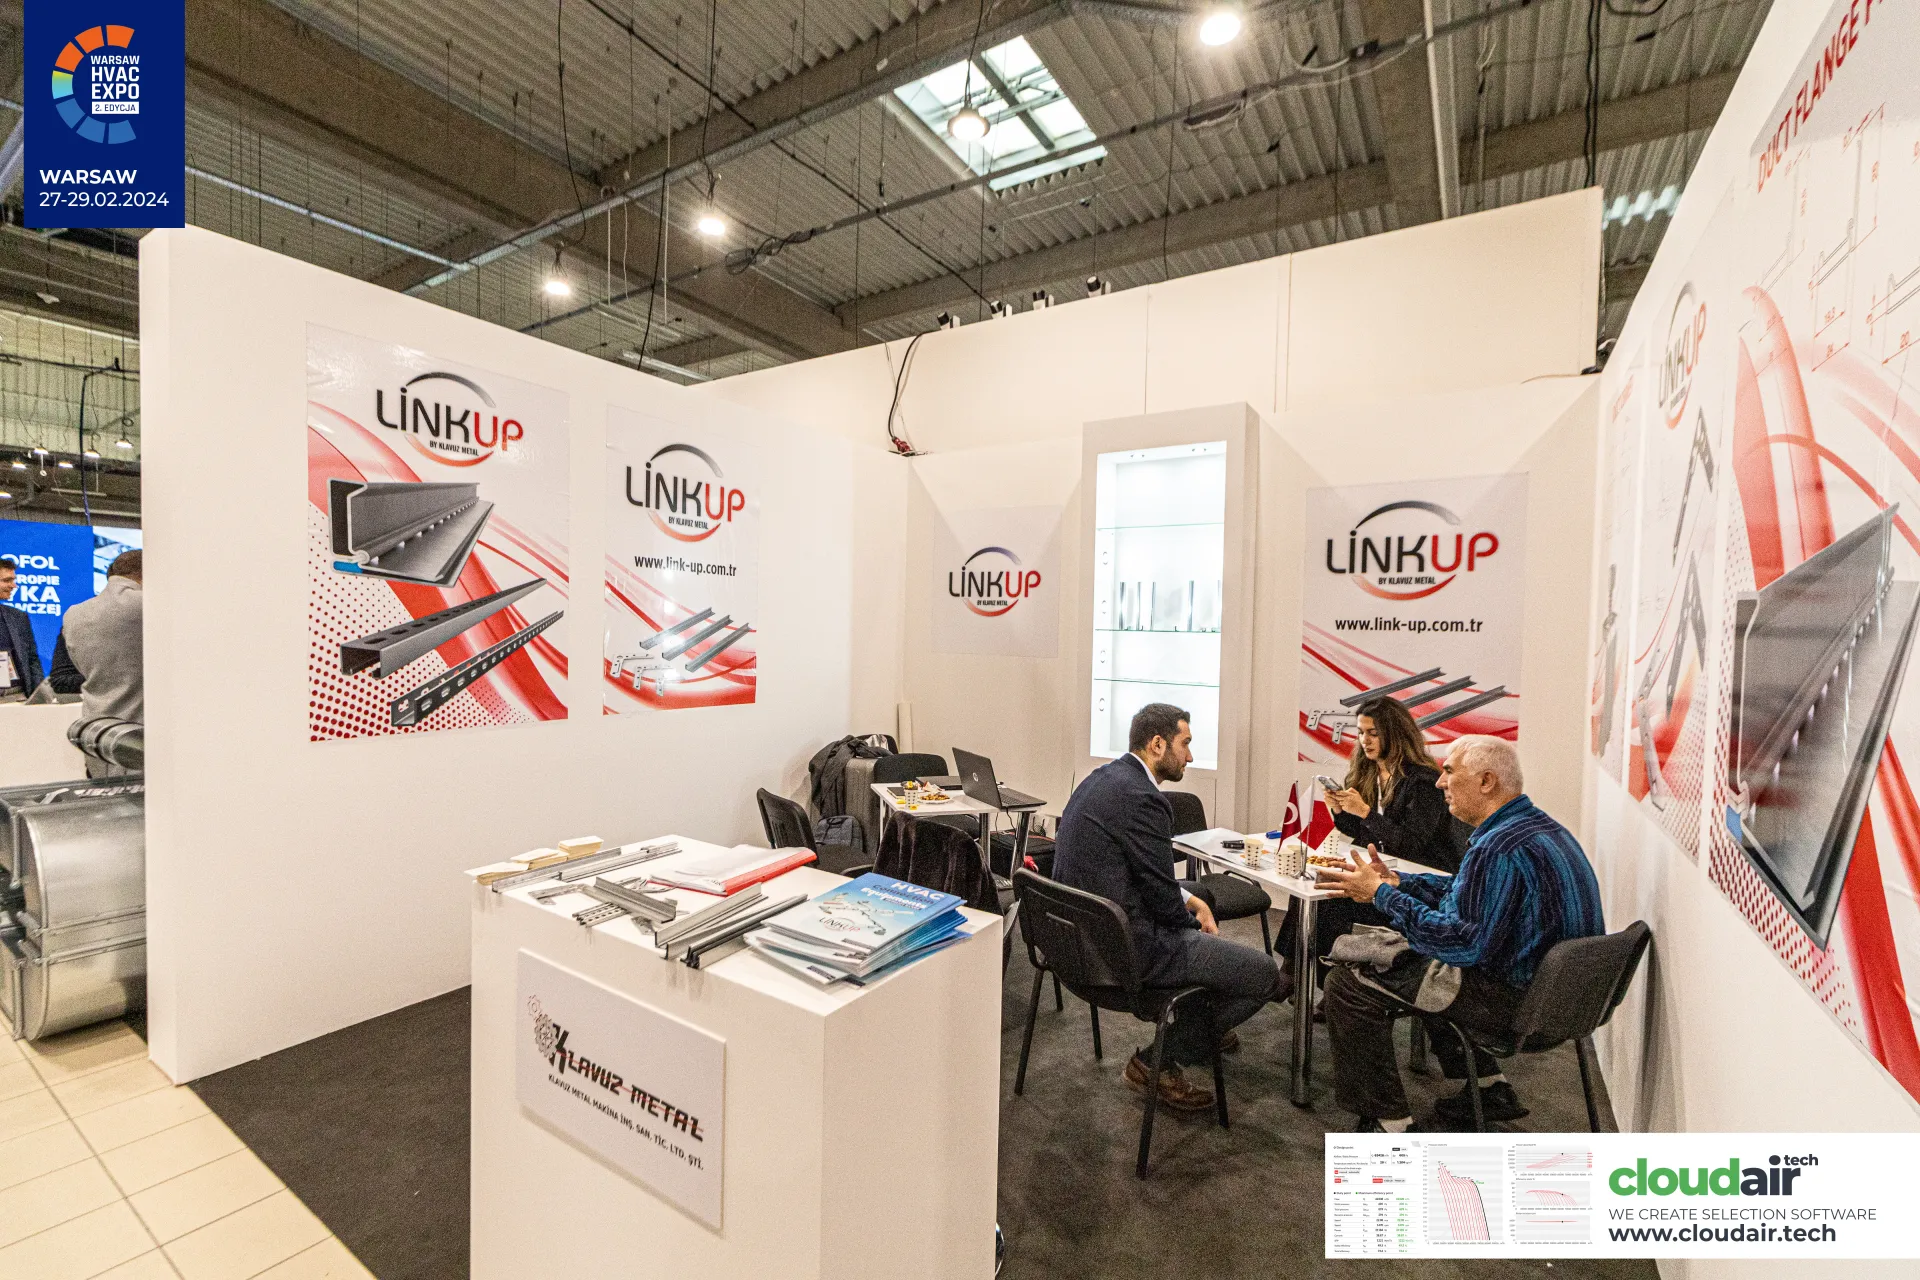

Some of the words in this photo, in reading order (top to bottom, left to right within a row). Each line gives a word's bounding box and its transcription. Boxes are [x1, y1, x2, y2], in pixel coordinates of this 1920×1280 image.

[1758, 106, 1793, 193] DUCT
[429, 440, 438, 449] BY
[438, 441, 460, 453] KLAVUZ
[461, 446, 480, 457] METAL
[14, 573, 61, 586] ROPIE
[1378, 577, 1387, 585] BY
[1388, 576, 1413, 585] KLAVUZ
[1414, 576, 1437, 585] METAL
[1335, 617, 1484, 634] www.link-up.com.tr
[890, 881, 945, 901] HVAC
[548, 1022, 624, 1097] KLAVUZ
[629, 1084, 704, 1143] METAL
[571, 1086, 592, 1106] METAL
